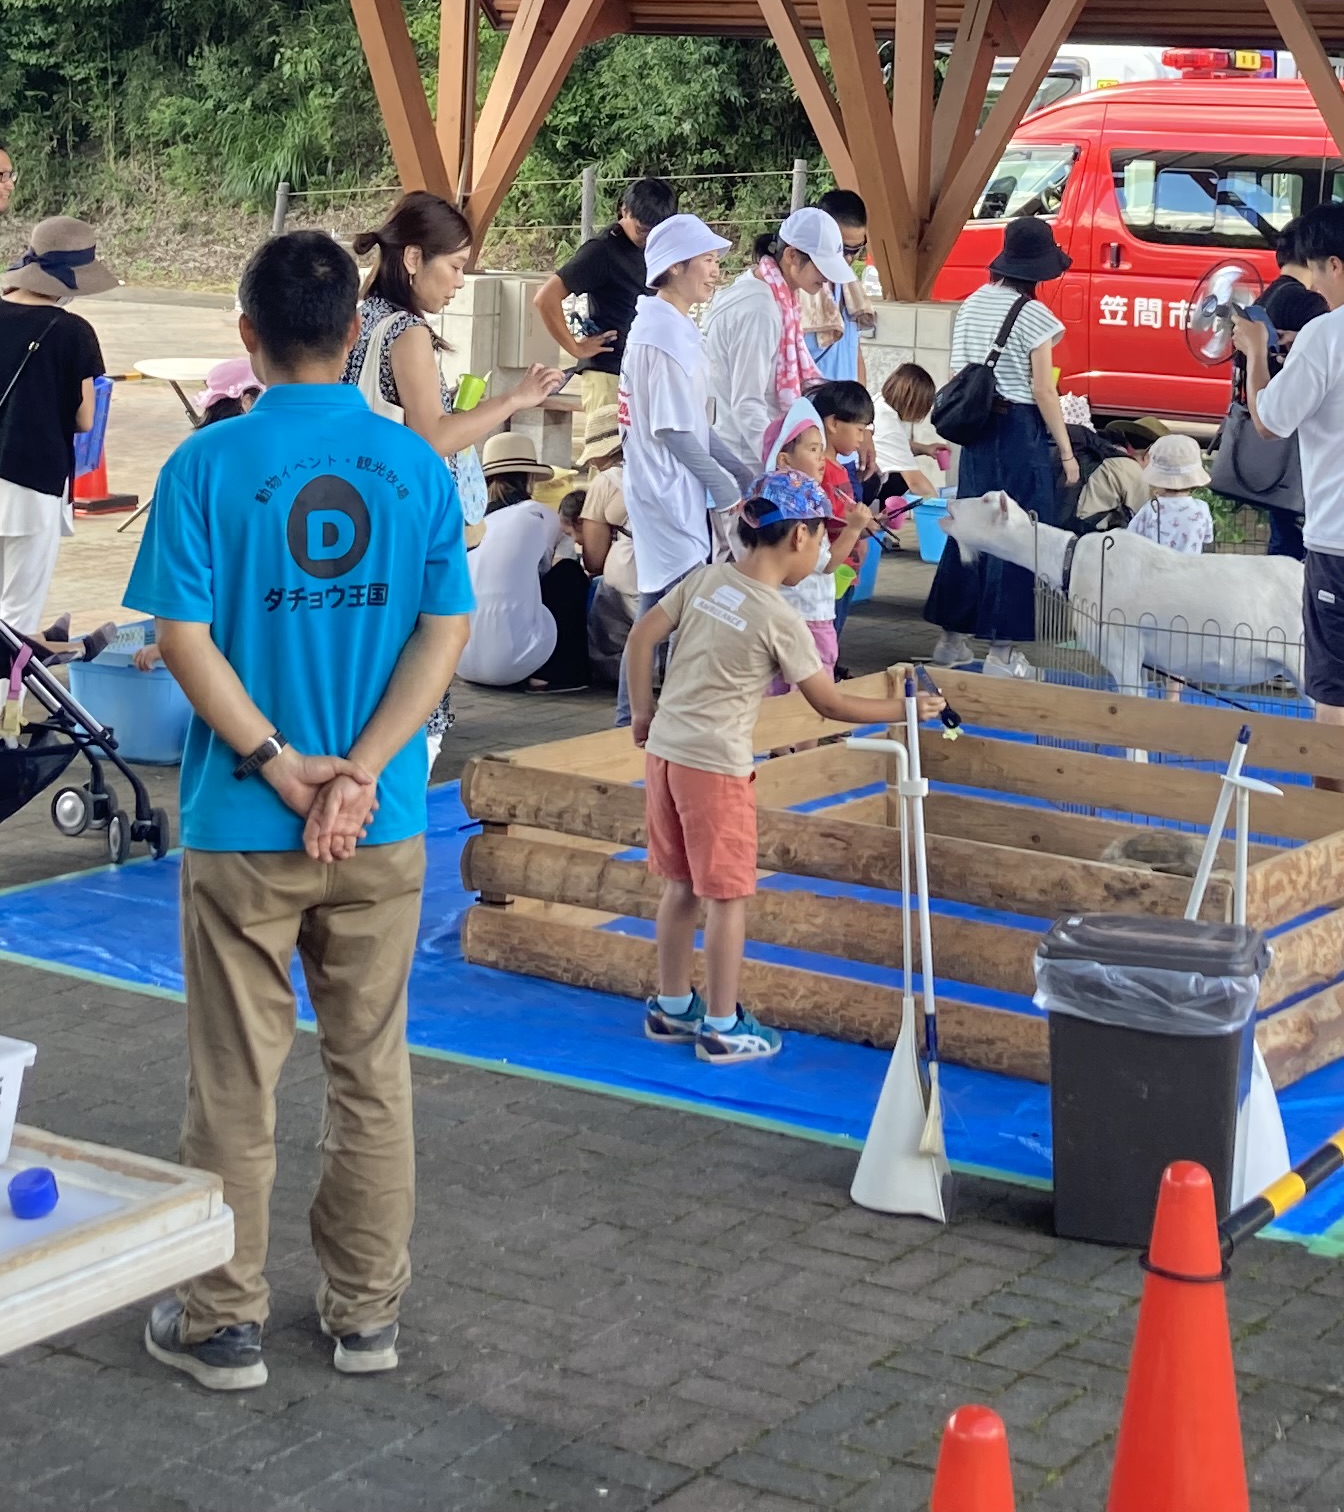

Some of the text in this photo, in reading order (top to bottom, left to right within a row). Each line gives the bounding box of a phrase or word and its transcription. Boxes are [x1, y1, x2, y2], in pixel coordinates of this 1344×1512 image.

[254, 454, 411, 505] 動物イベント・観光牧場
[305, 509, 356, 561] D
[263, 583, 389, 612] ダチョウ王国
[696, 599, 744, 629] AMBULANCE
